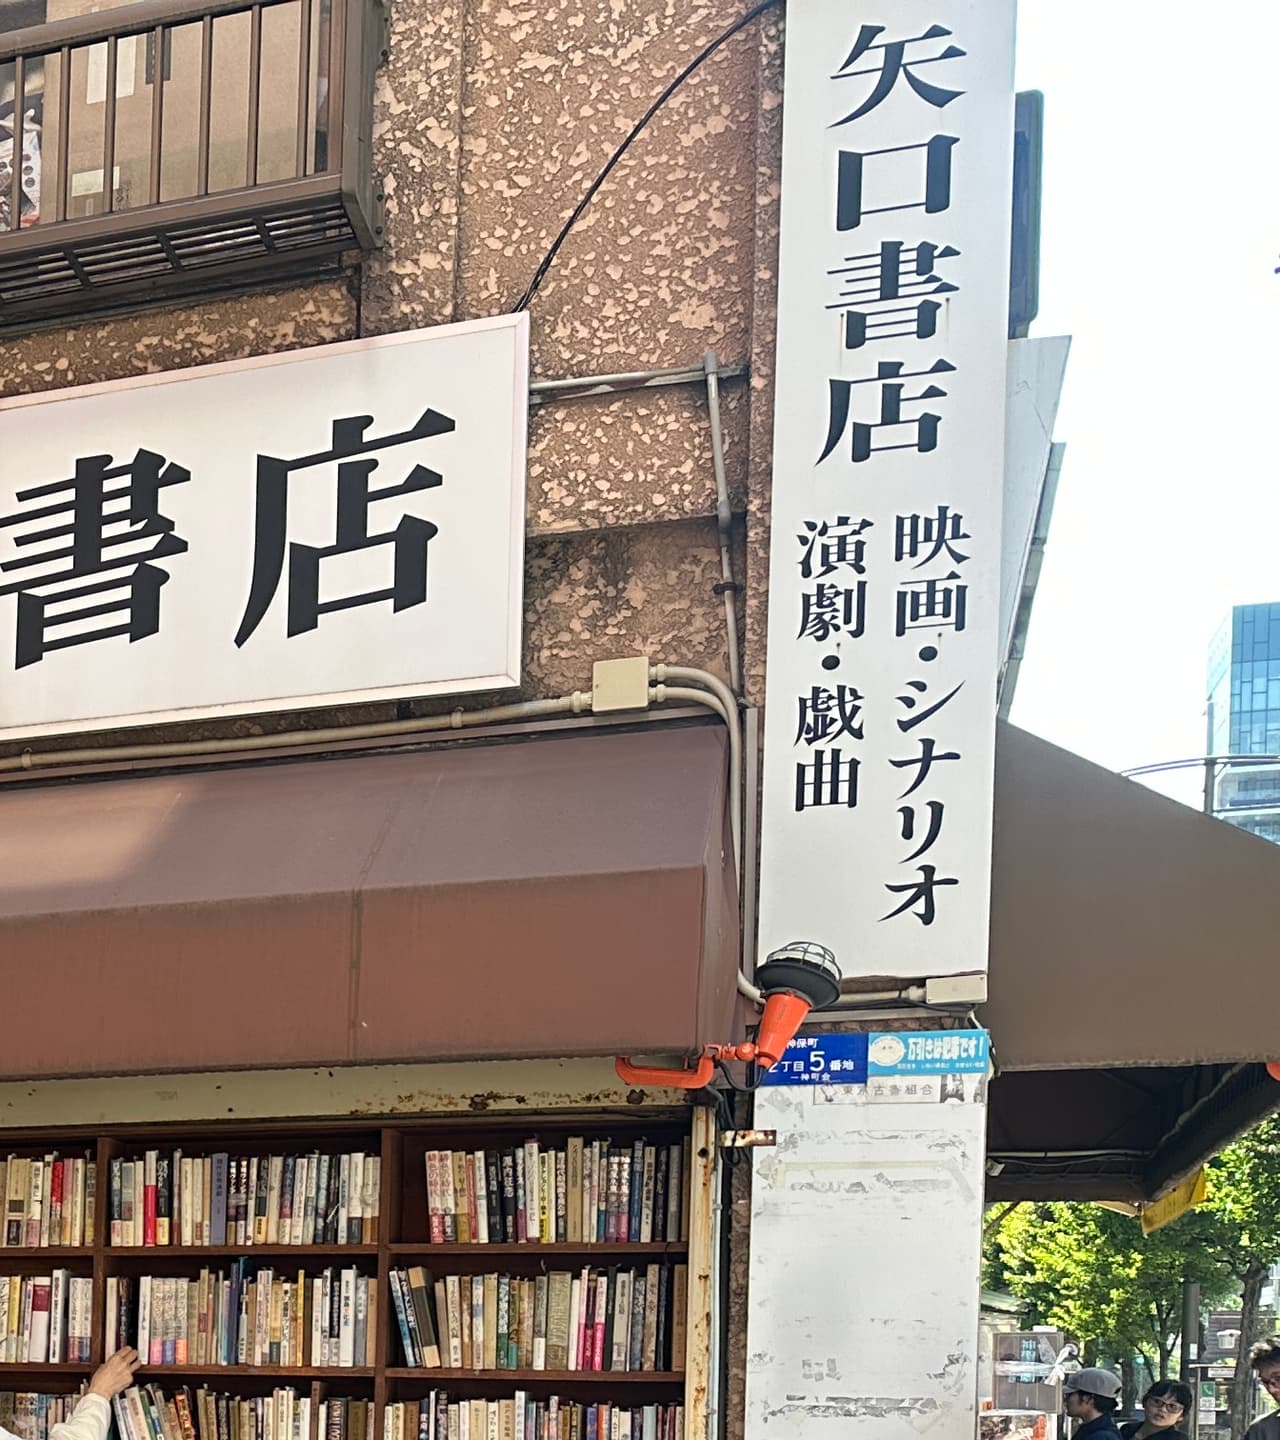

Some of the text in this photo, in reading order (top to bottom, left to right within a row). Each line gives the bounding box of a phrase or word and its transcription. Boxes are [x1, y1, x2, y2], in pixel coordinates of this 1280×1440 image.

[814, 24, 968, 467] 矢口書店
[793, 515, 875, 813] 演劇・戯曲
[877, 505, 971, 927] 映画・シナリオ
